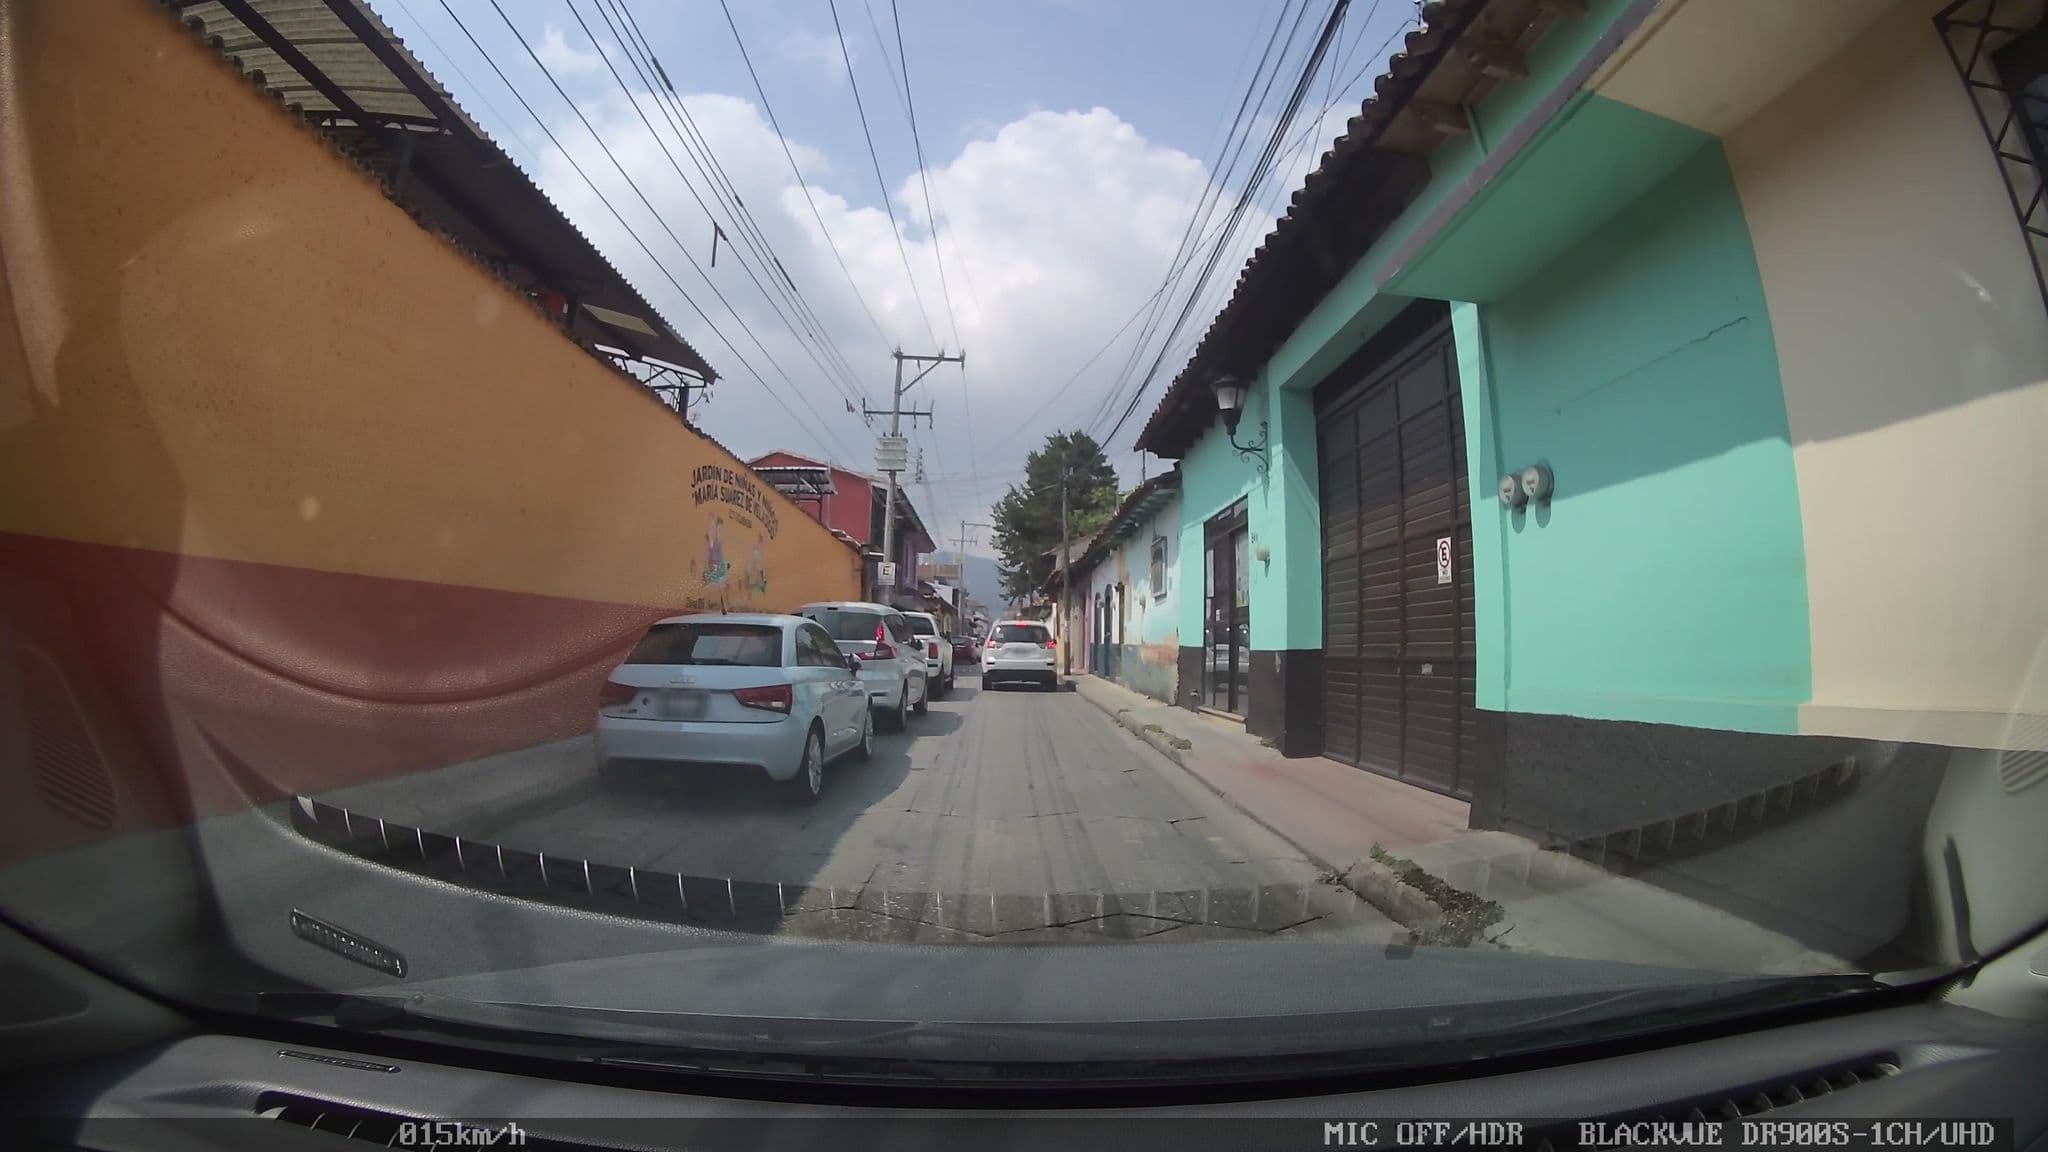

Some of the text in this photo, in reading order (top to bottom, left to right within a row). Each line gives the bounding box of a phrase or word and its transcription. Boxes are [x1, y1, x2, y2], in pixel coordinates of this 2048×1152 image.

[691, 465, 721, 488] JARDIN
[723, 469, 734, 485] DE
[745, 495, 752, 513] DE
